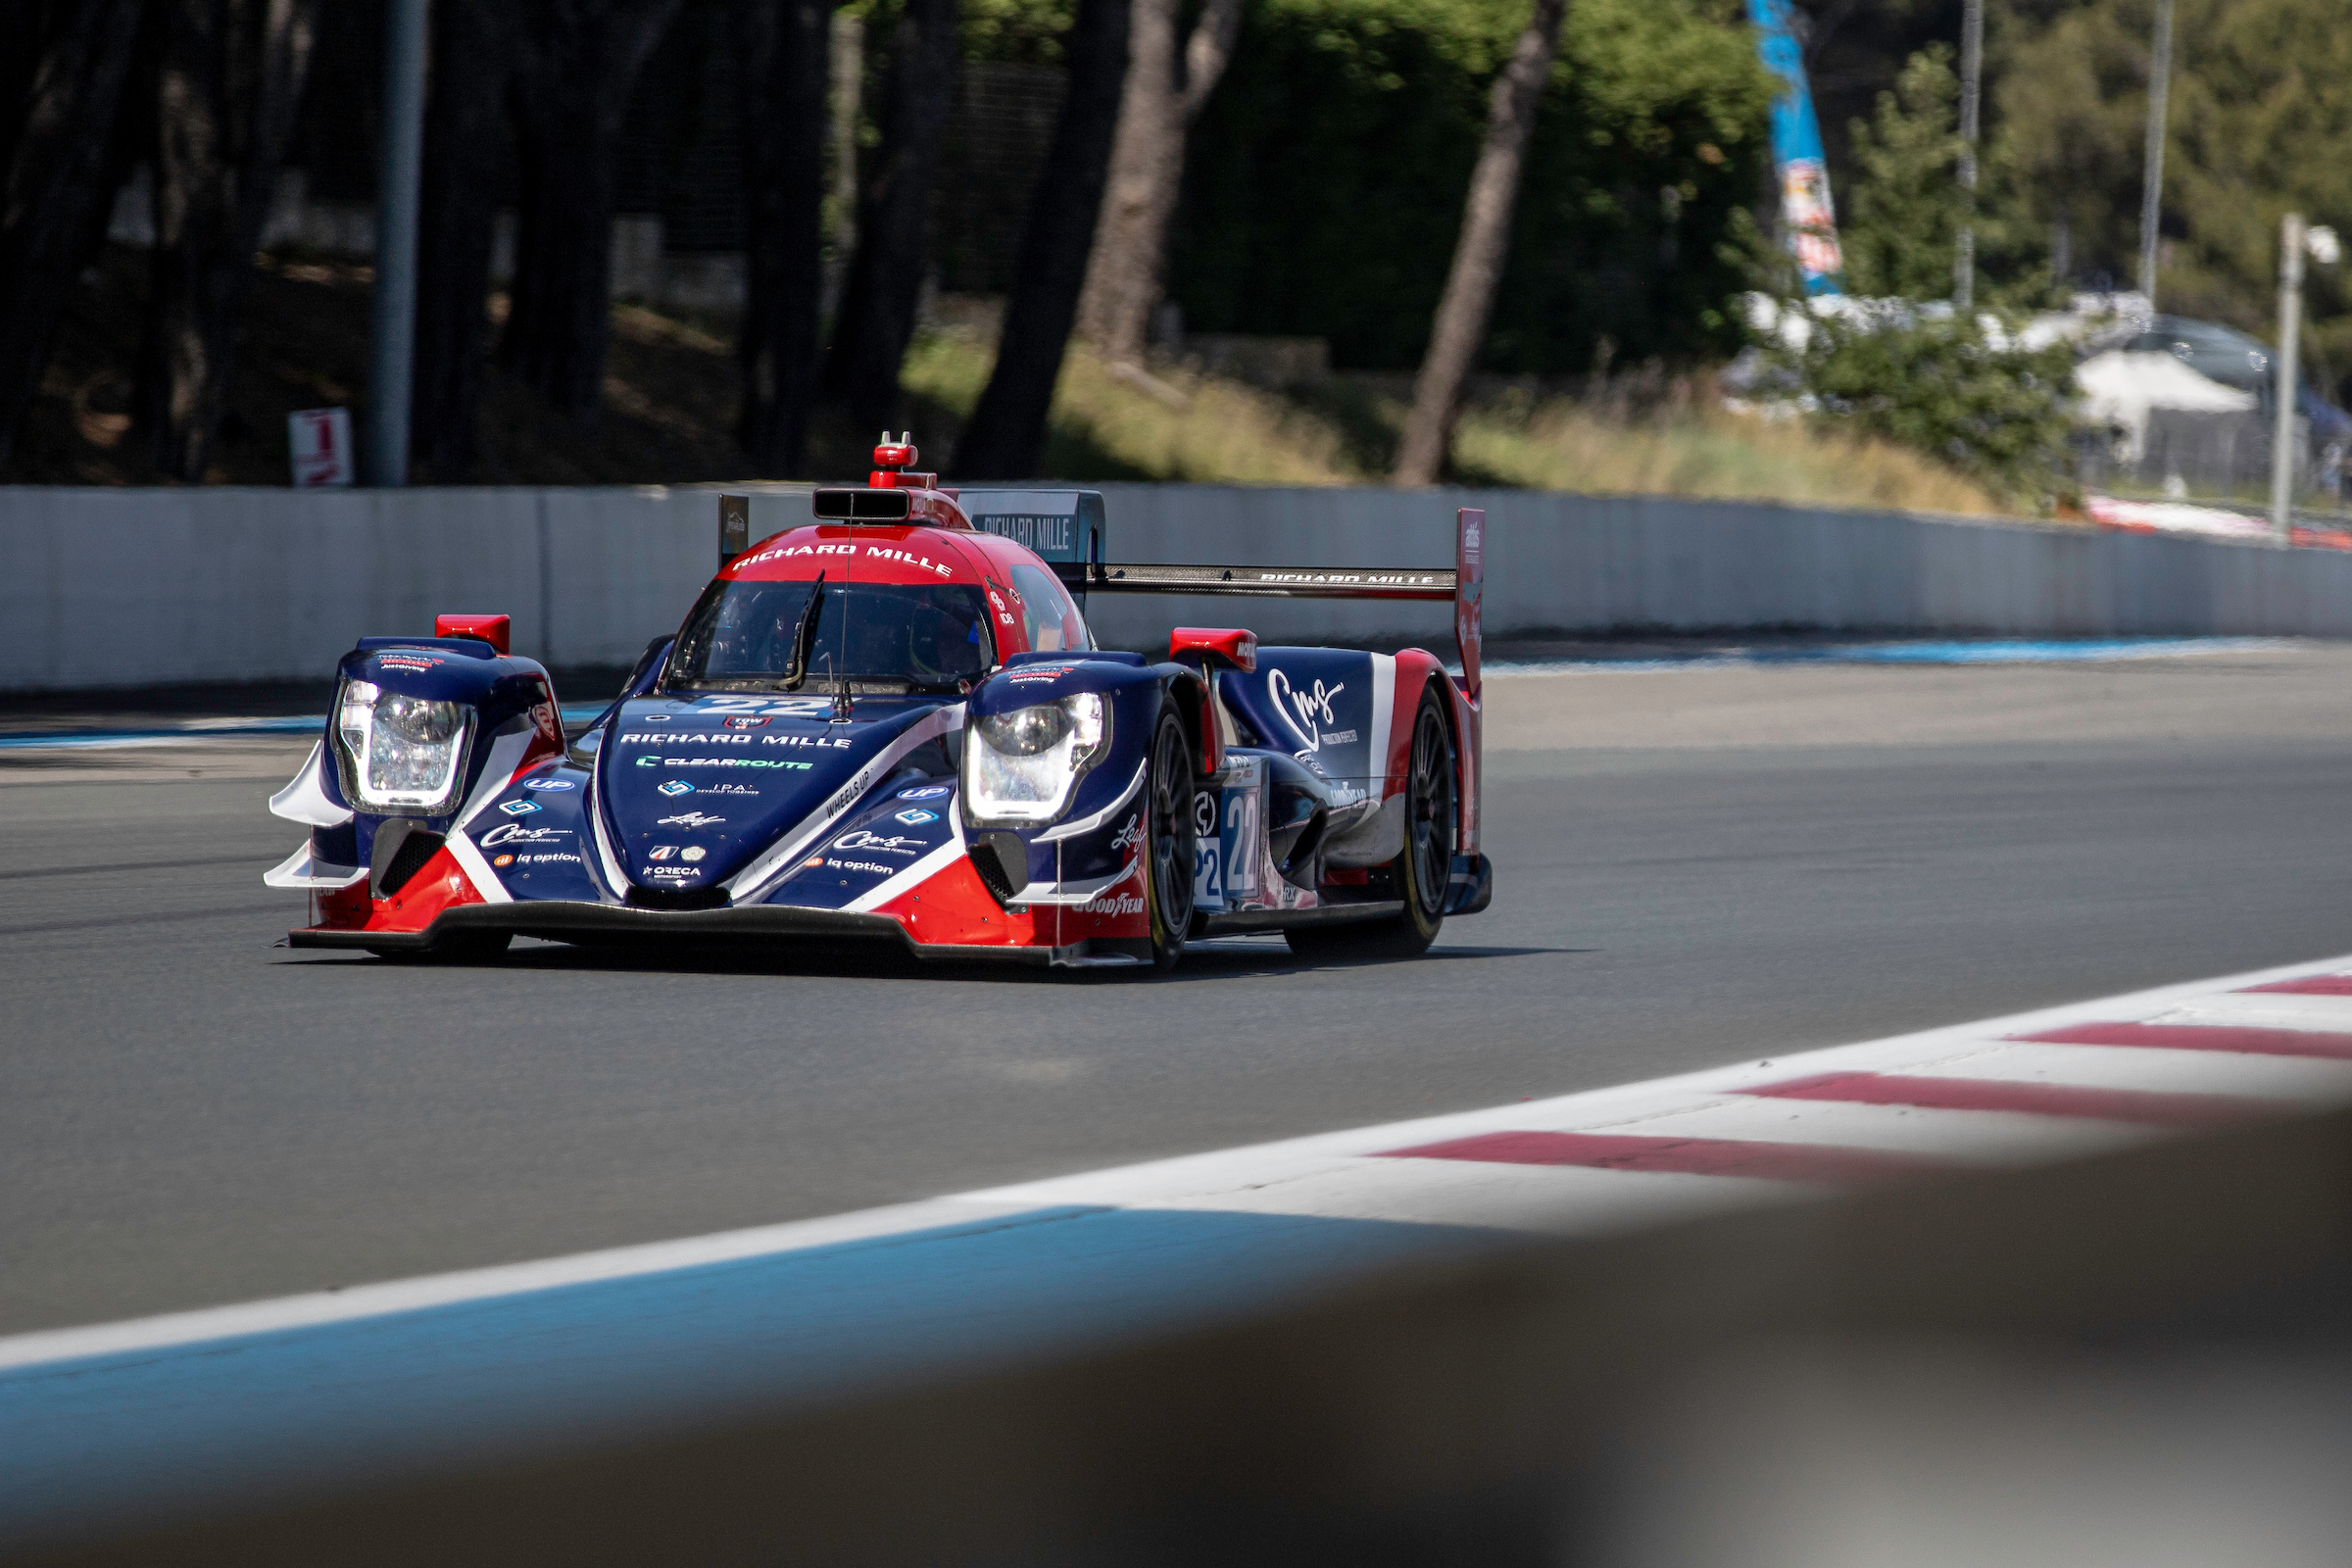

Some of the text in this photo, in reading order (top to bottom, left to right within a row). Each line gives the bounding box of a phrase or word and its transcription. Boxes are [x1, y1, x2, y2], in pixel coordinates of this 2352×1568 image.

[1037, 518, 1069, 550] MILLE
[732, 545, 953, 577] RICHARD MILLE
[1260, 573, 1434, 584] RICHARD MILLE
[697, 699, 832, 715] 22
[620, 733, 853, 749] RICHARD MILLE
[663, 758, 814, 770] CLEARROUTE
[527, 779, 572, 789] UP
[826, 770, 870, 818] WHEELS UP
[901, 787, 946, 798] UP
[1227, 796, 1256, 890] 22
[516, 853, 581, 863] iq option
[654, 866, 702, 875] ORECA
[826, 858, 894, 875] iq option
